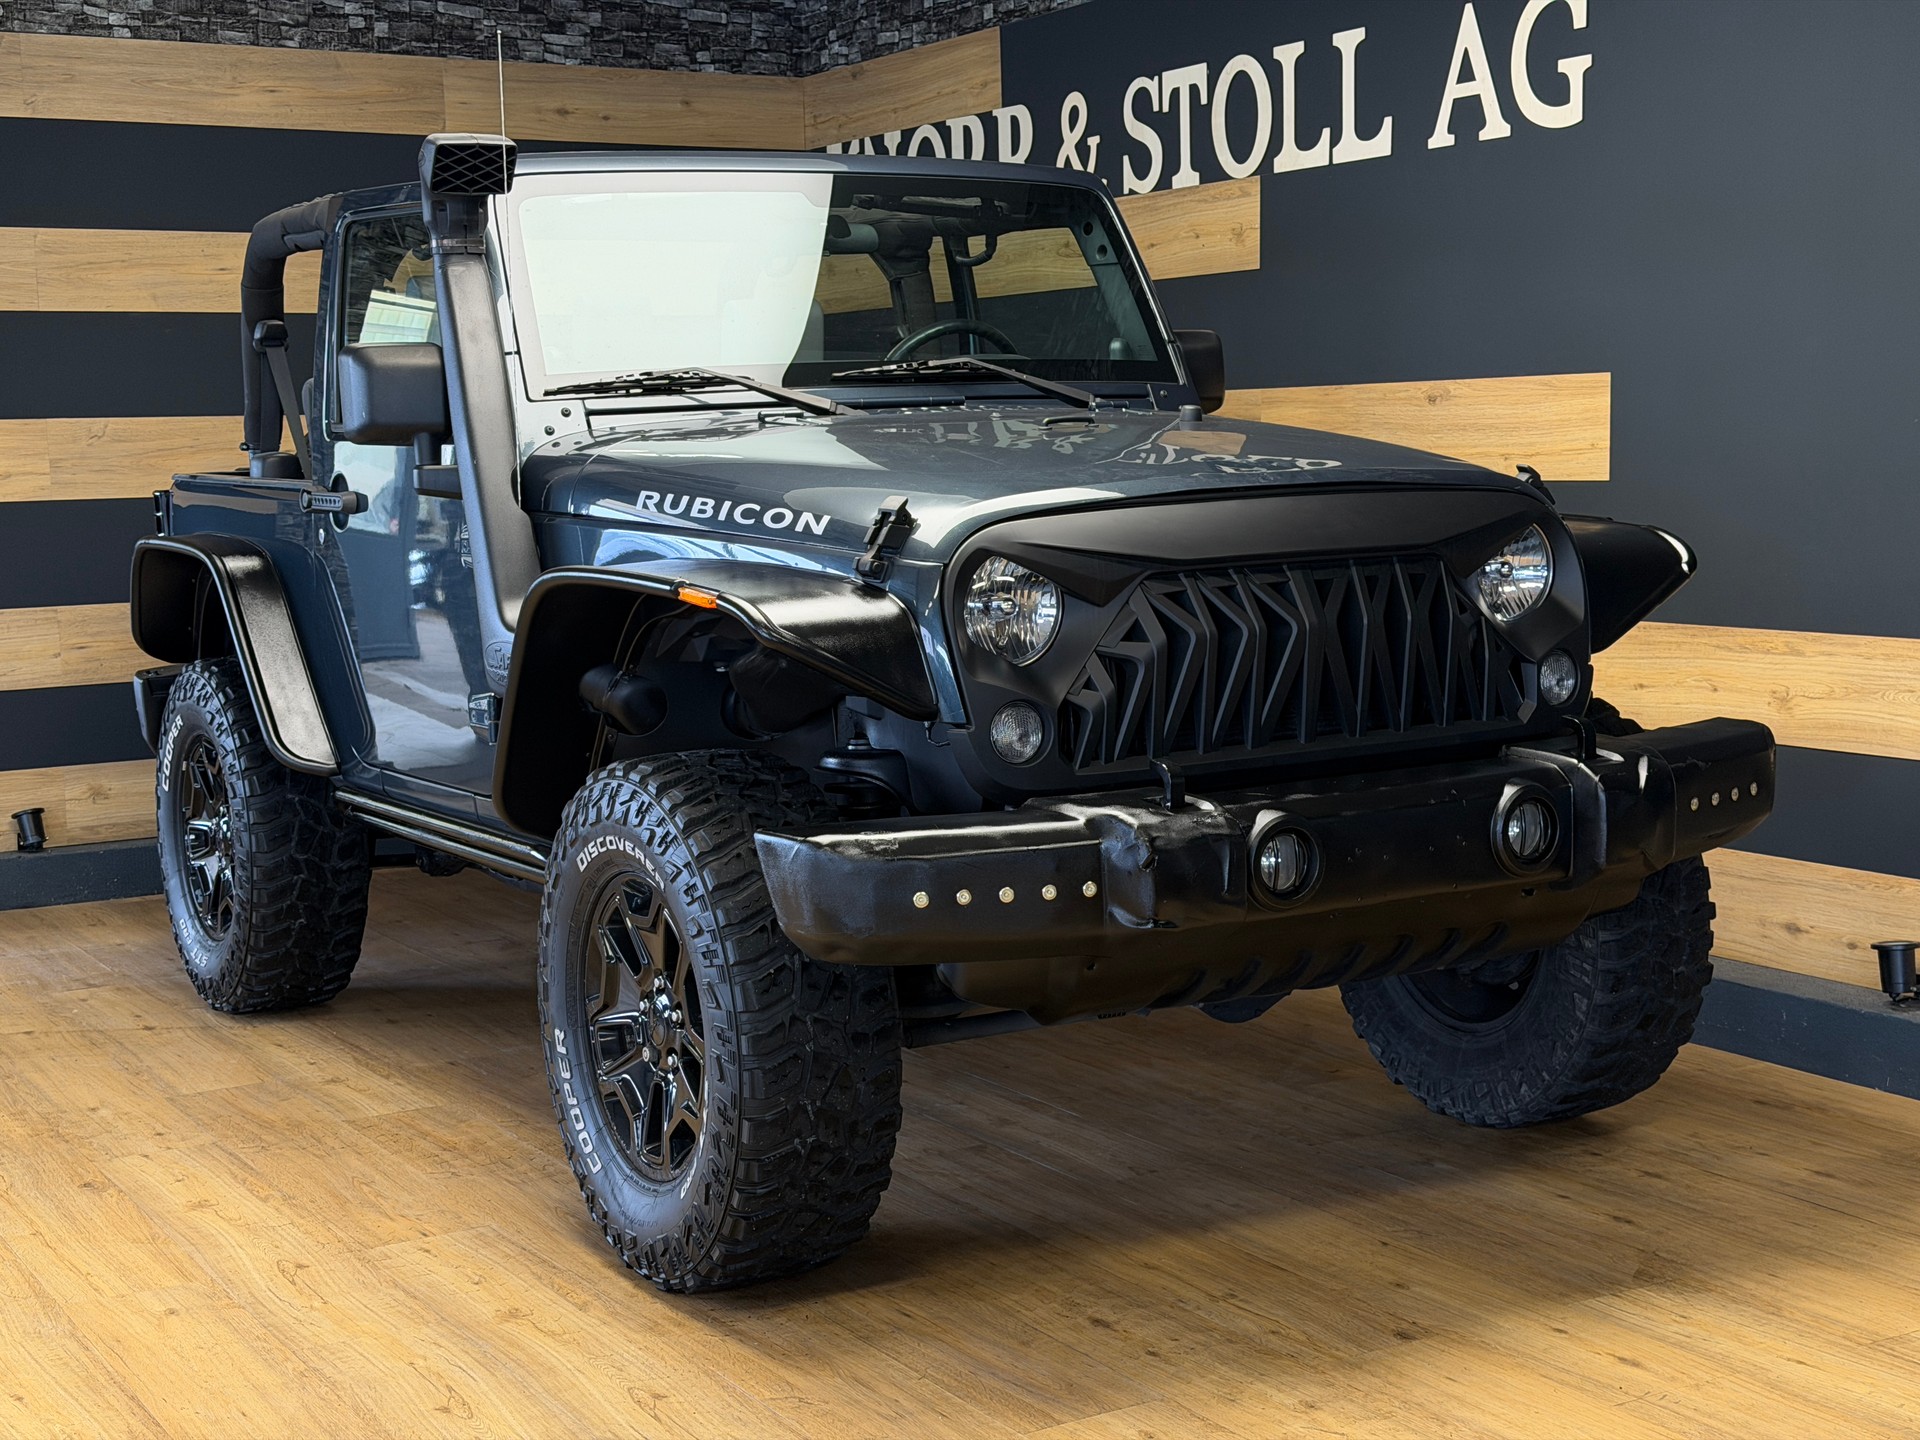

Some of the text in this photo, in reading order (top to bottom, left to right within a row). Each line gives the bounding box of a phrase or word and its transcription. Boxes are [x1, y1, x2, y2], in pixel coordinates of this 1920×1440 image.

[1123, 27, 1393, 195] STOLL
[1427, 0, 1593, 150] AG
[635, 490, 831, 535] RUBICON
[162, 715, 183, 792] COOPER
[576, 835, 666, 891] DISCOVERER
[555, 1028, 603, 1175] COOPER
